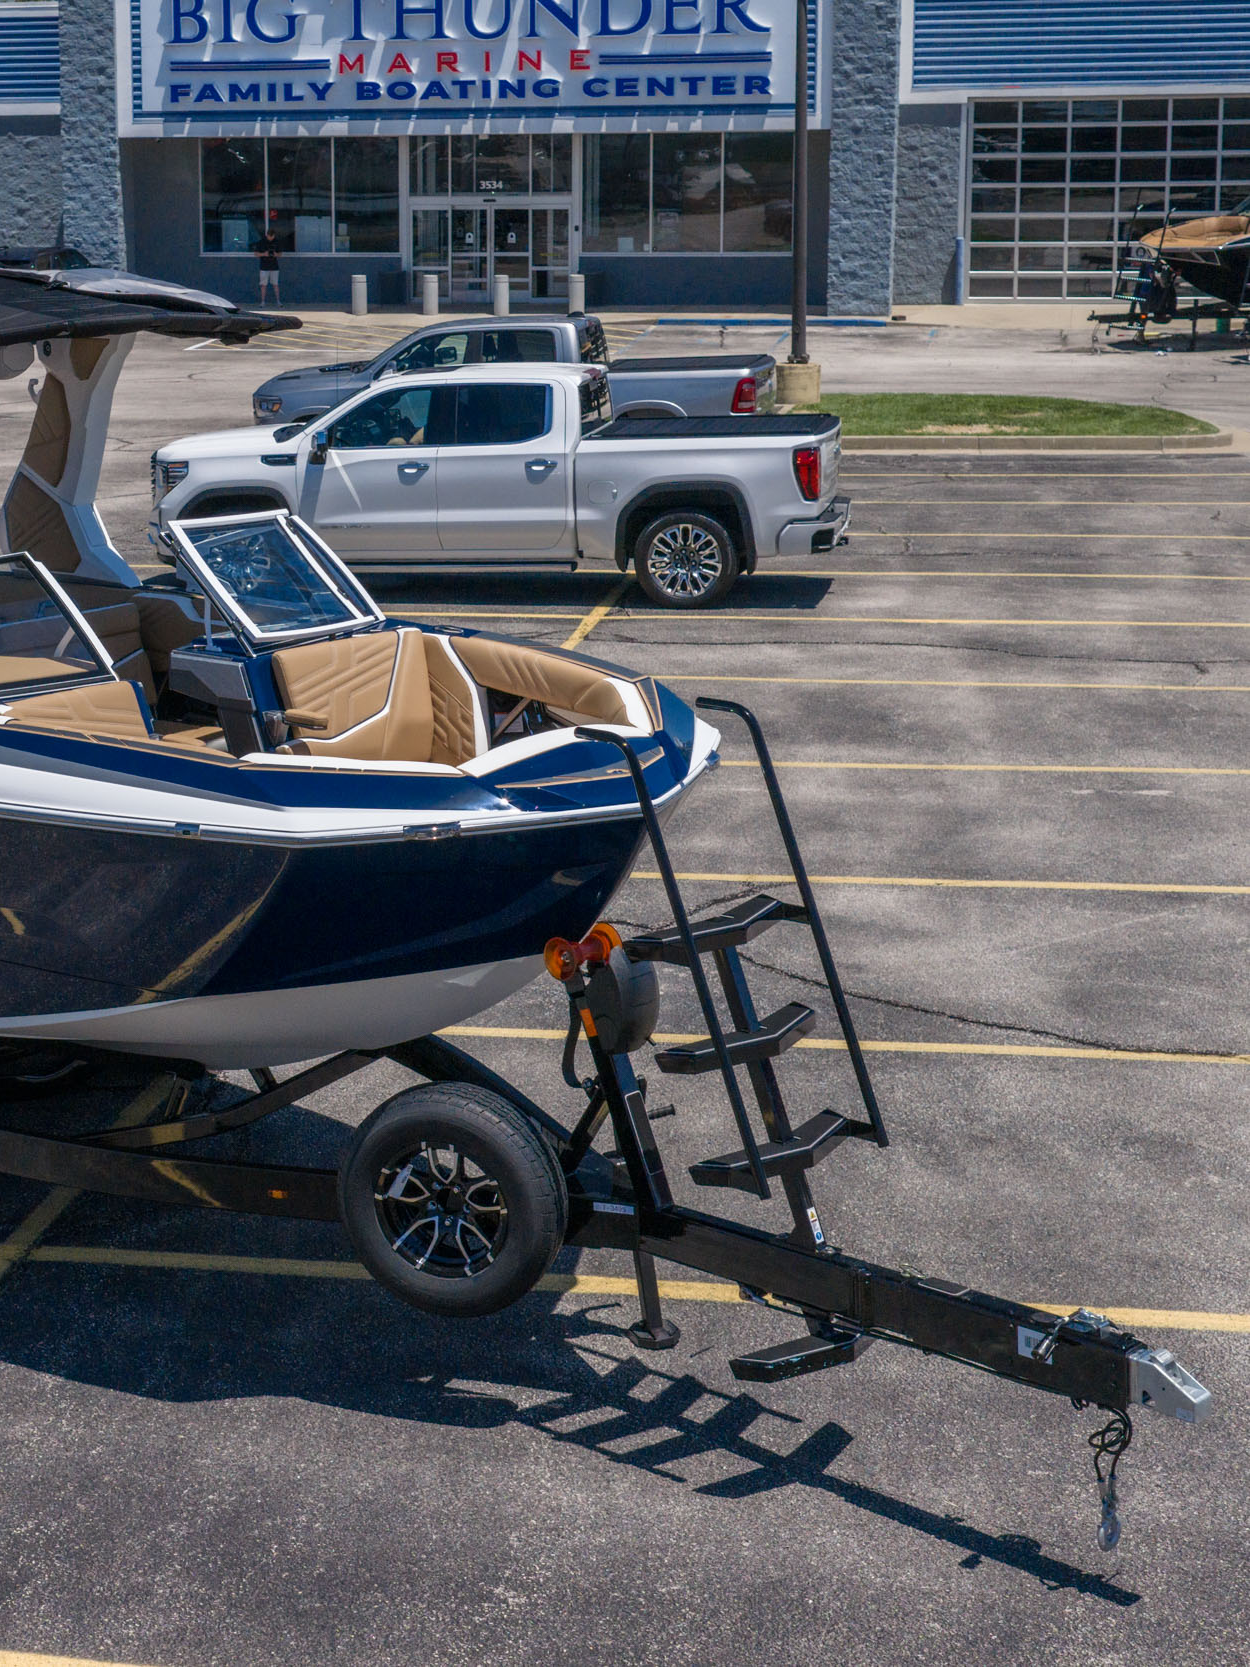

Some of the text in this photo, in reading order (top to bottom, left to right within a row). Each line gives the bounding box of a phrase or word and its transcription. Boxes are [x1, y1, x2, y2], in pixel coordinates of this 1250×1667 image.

[165, 0, 308, 43] BIG
[338, 49, 591, 74] MARINE
[169, 75, 772, 103] FAMILY BOATING CENTER
[479, 181, 503, 190] 3534
